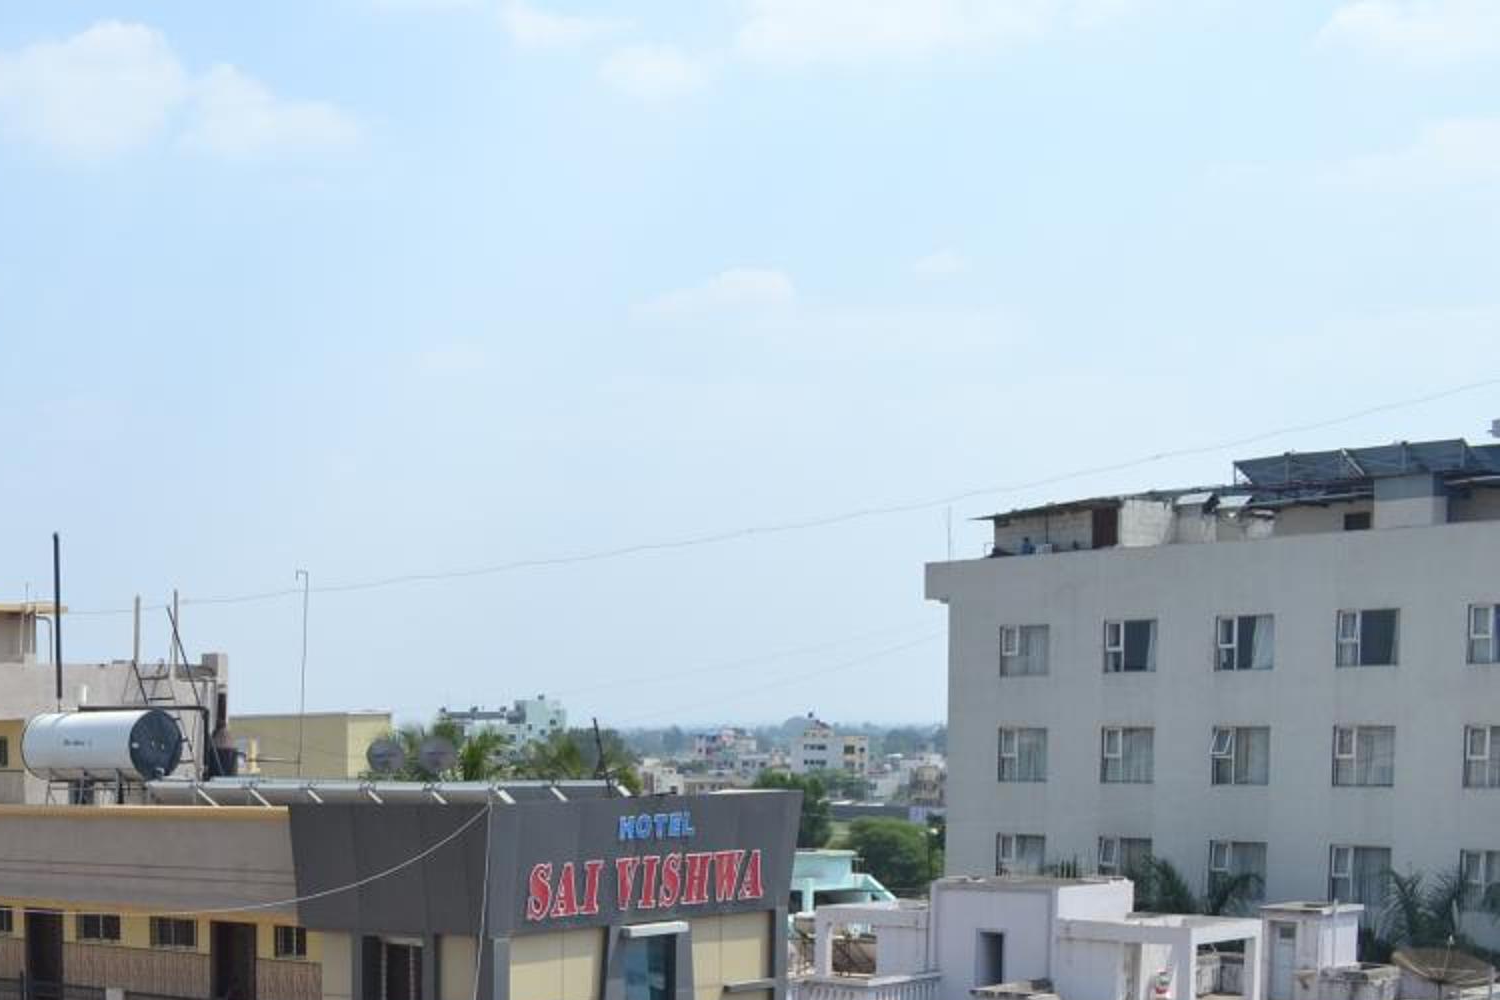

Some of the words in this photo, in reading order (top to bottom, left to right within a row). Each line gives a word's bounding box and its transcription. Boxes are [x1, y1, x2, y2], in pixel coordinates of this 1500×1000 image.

[618, 810, 695, 841] HOTEL
[526, 859, 604, 922] SAI
[615, 848, 765, 911] VISHWA
